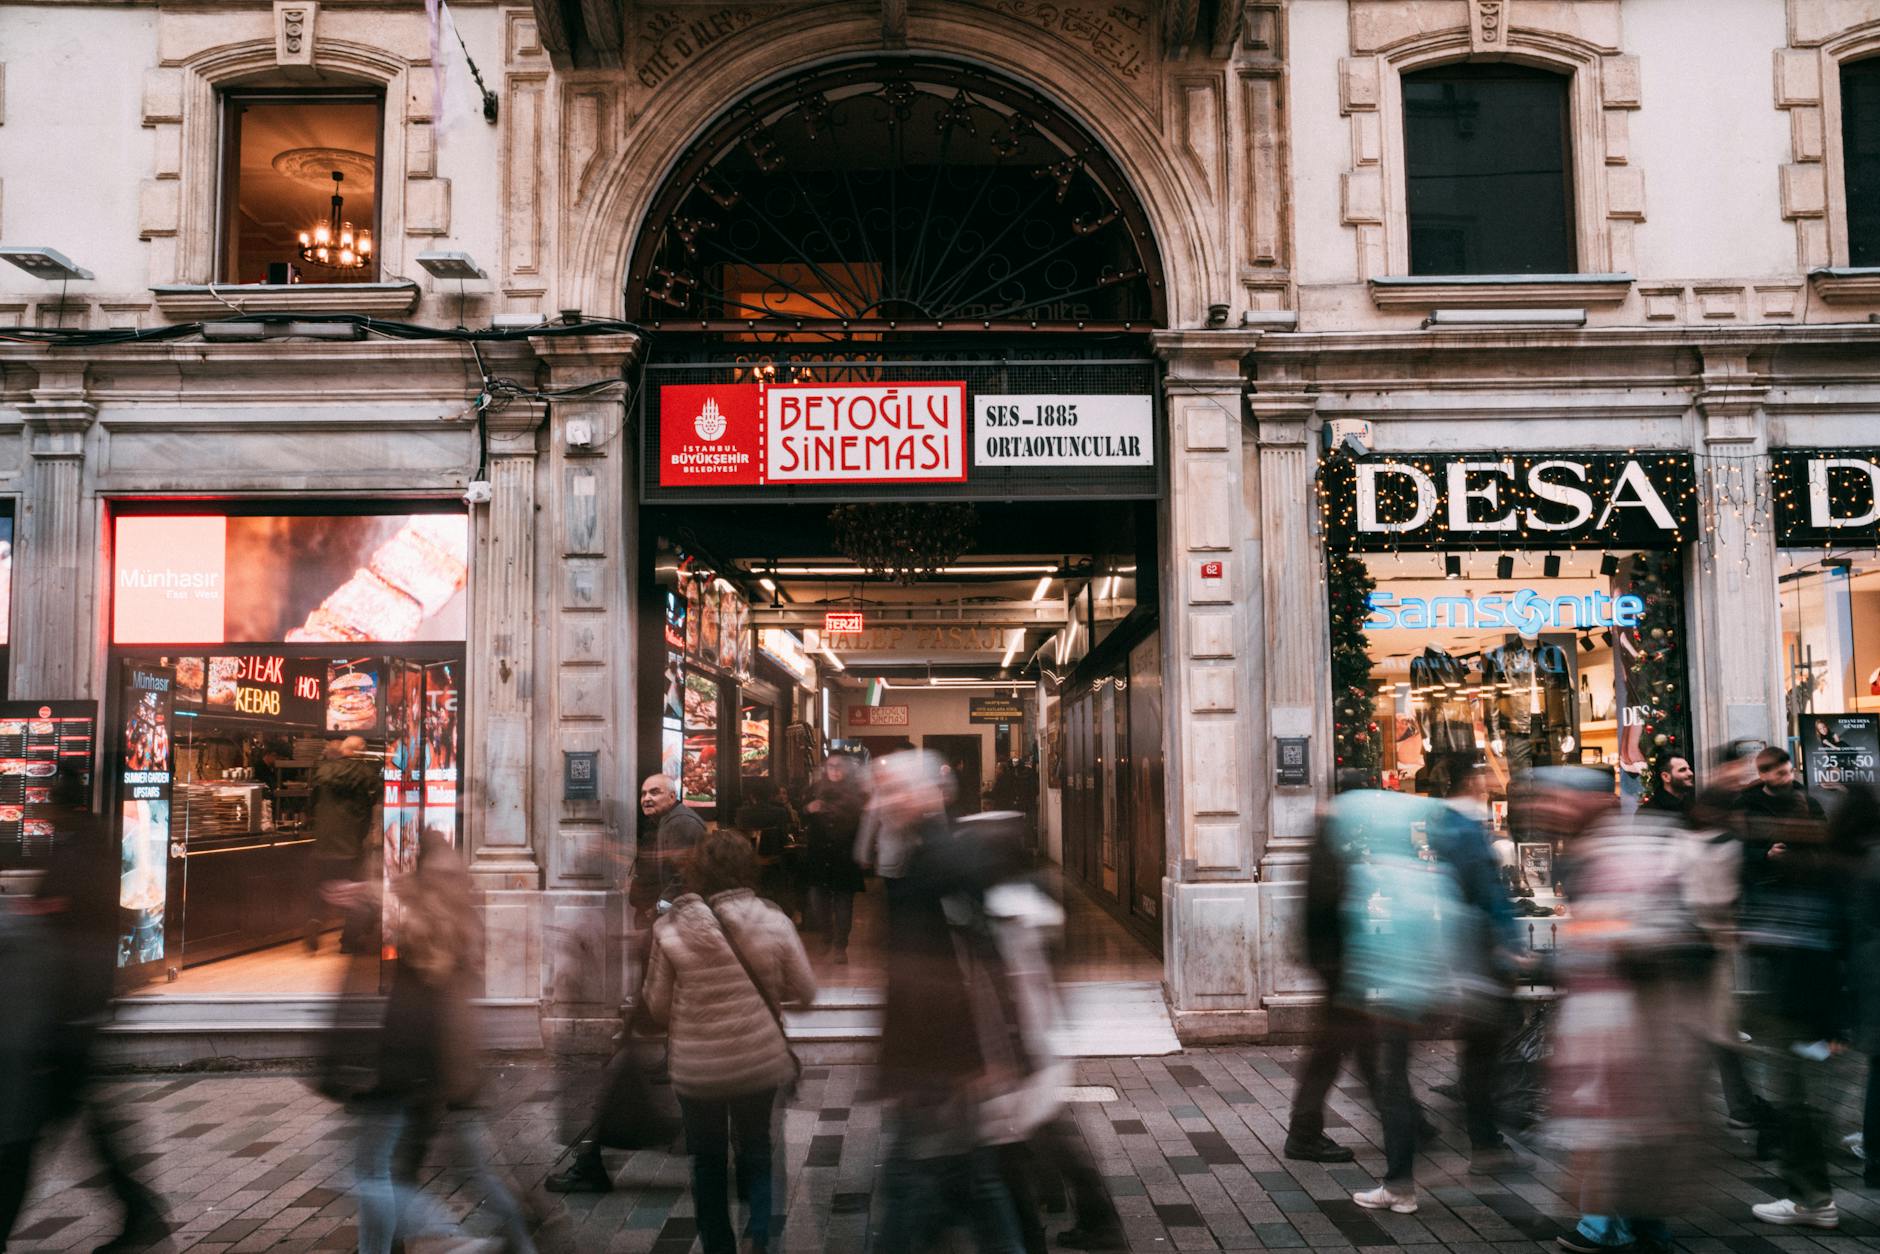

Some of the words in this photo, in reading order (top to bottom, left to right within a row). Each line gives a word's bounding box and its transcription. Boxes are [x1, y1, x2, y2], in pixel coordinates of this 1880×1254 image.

[781, 389, 949, 431] BEYOĞLU
[986, 436, 1141, 457] ORTAOYUNCULAR
[671, 452, 749, 465] BÜYÜKŞEHİR
[683, 465, 737, 473] BELEDİYESİ
[1355, 460, 1679, 533] DESA
[120, 568, 219, 587] Münhasır
[1206, 564, 1218, 575] 62
[1363, 588, 1646, 635] Samsonite
[828, 617, 860, 630] TERZİ
[235, 686, 281, 715] KEBAB
[1813, 767, 1874, 783] İNDİRİM
